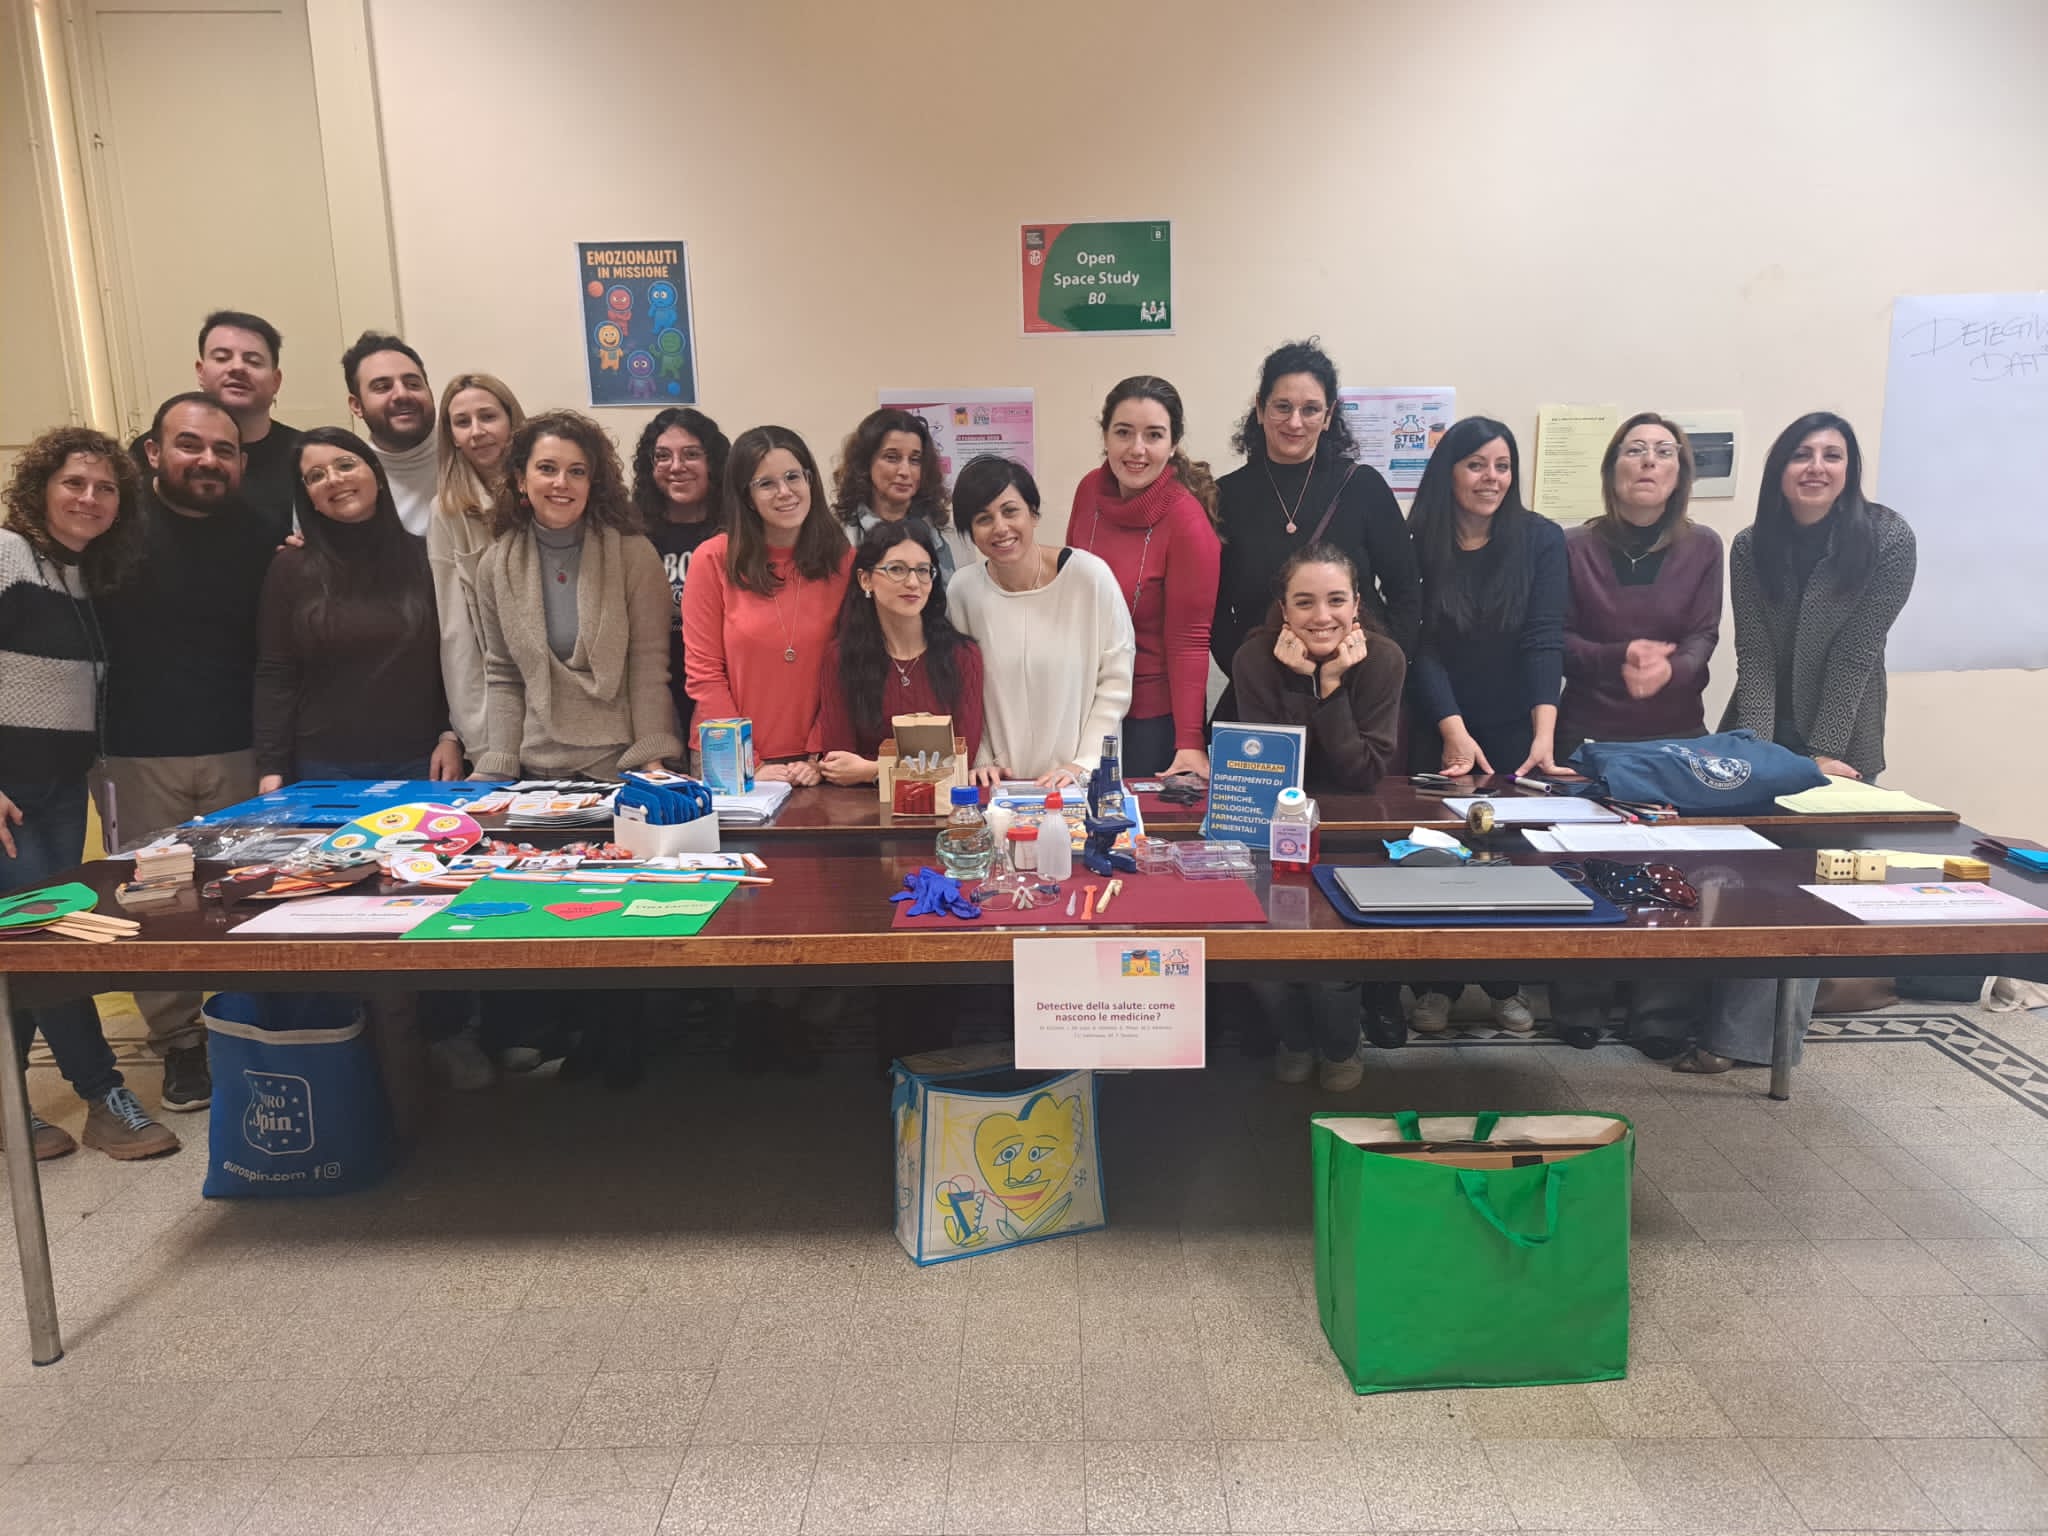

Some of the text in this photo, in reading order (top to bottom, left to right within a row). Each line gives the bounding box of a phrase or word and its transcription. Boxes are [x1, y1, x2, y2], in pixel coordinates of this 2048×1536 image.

[586, 250, 678, 266] EMOZIONAUTI
[1077, 252, 1116, 267] Open
[597, 265, 669, 279] IN MISSIONE
[1053, 271, 1140, 288] Space Study
[1394, 434, 1425, 443] STEM
[1214, 774, 1272, 785] DIPARTIMENTO
[1213, 784, 1248, 793] SCIENZE
[1211, 823, 1257, 834] AMBIENTALI
[1036, 1001, 1176, 1011] Detective della salute: come
[1055, 1012, 1161, 1021] nascono le medicine?
[223, 1160, 306, 1183] eurospin.com
